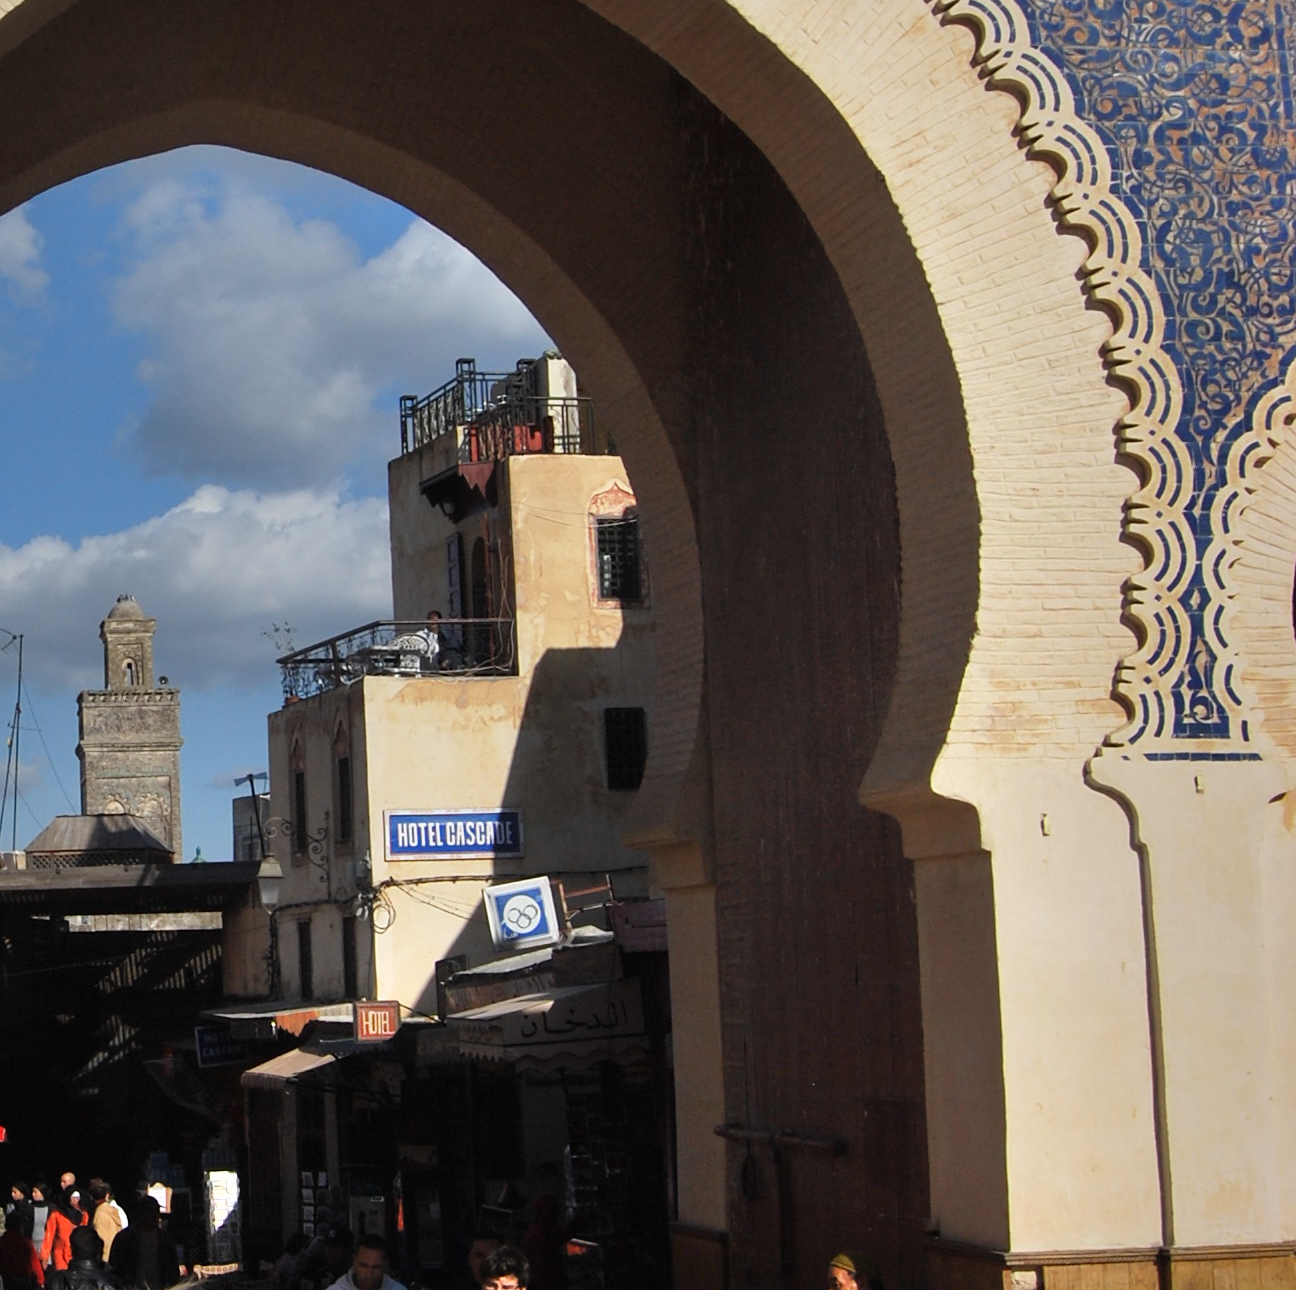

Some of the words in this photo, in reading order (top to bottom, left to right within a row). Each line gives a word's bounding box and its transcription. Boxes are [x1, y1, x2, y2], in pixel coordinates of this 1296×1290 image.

[397, 822, 443, 847] HOTEL
[446, 821, 513, 846] CASCADE
[361, 1010, 395, 1036] HOTEL
